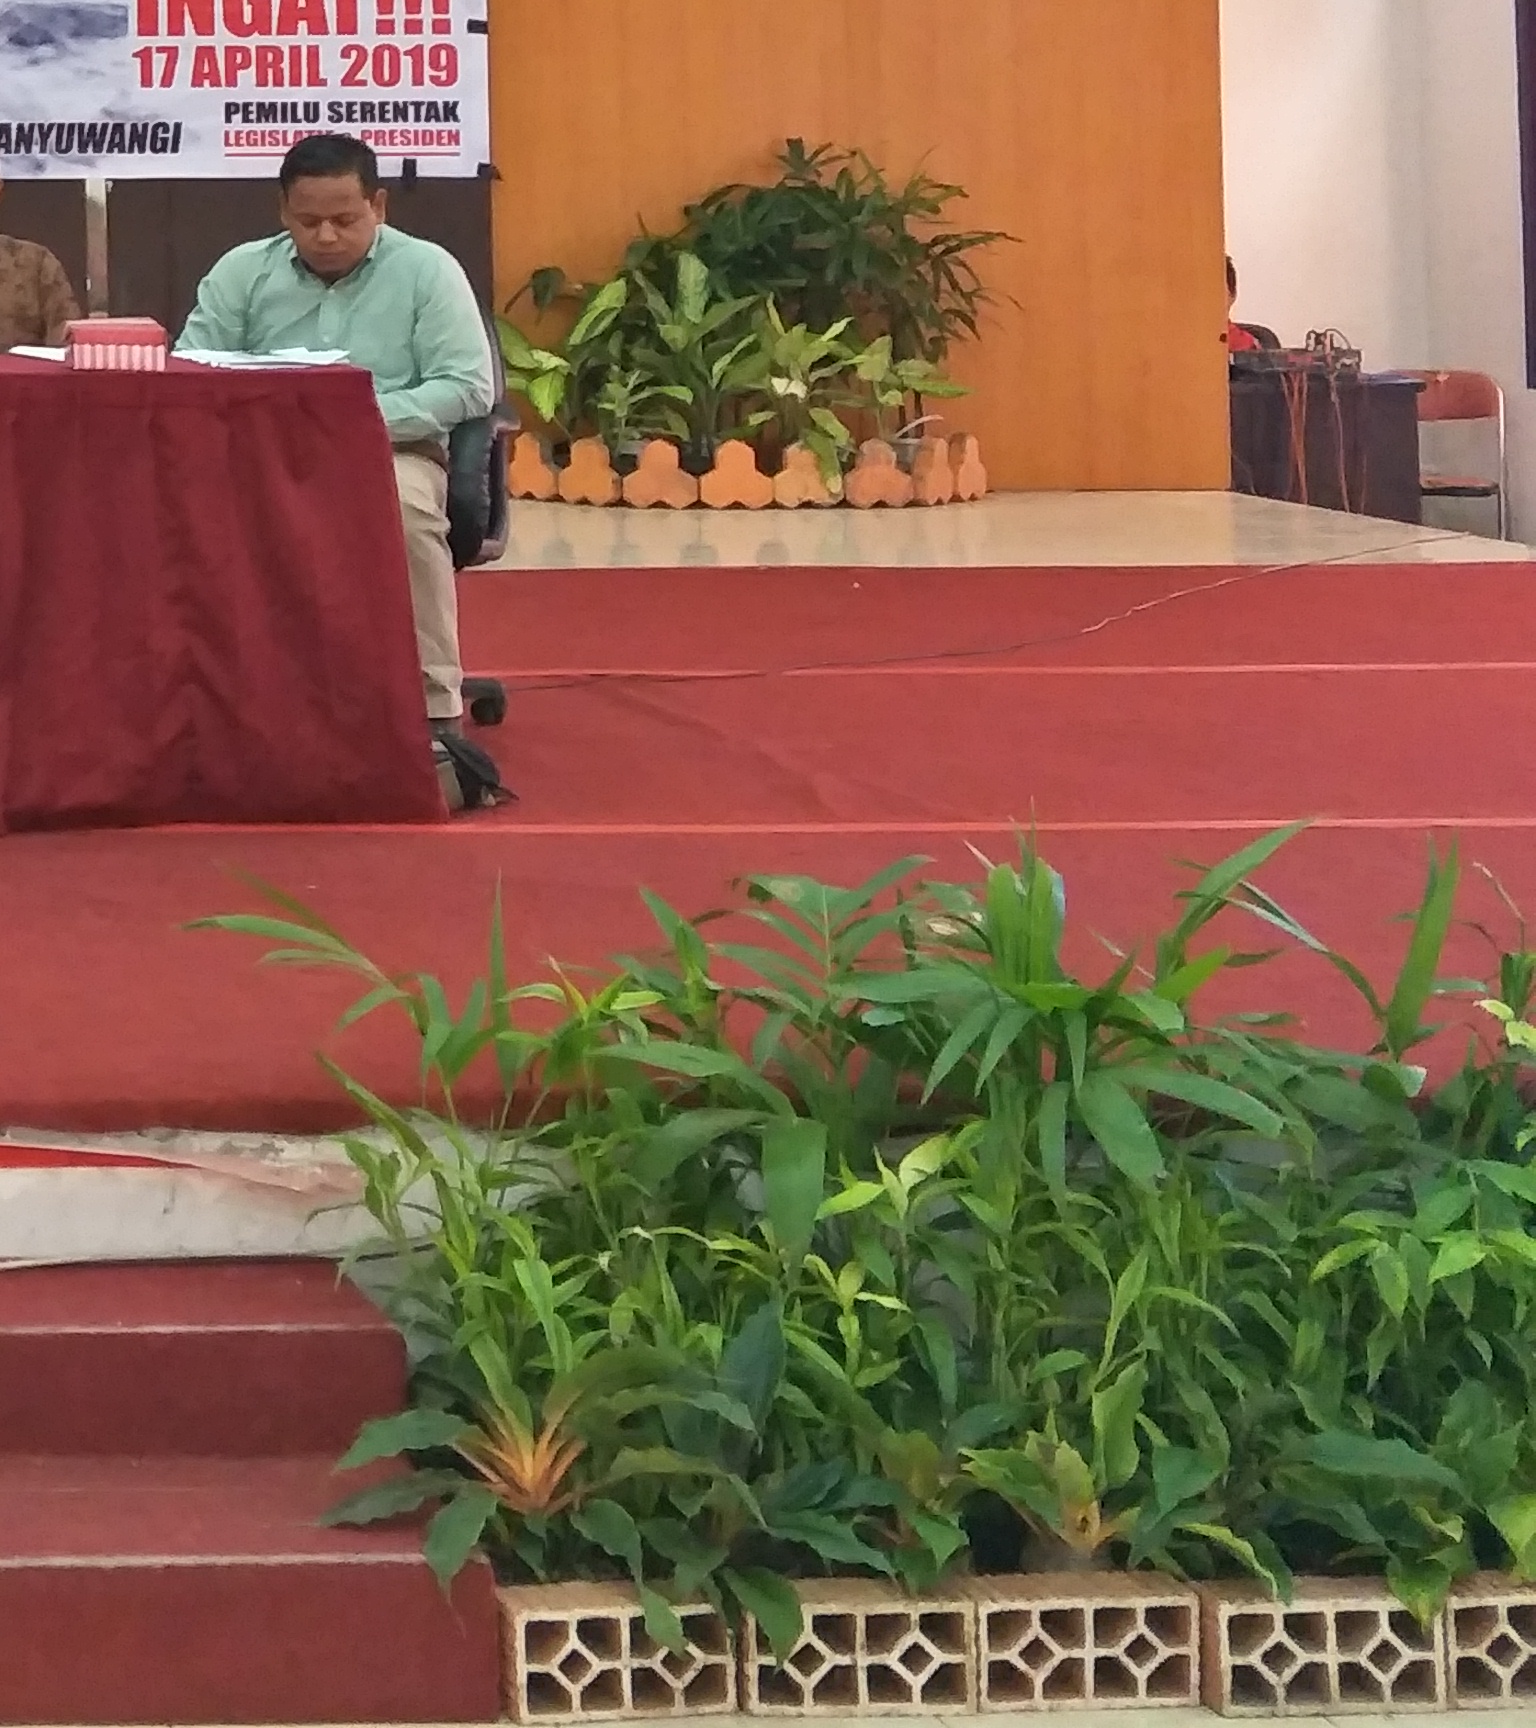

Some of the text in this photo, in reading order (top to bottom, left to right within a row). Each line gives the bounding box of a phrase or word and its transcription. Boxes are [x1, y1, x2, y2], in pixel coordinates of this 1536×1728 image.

[132, 43, 459, 88] 17 APRIL 2019
[225, 100, 461, 124] PEMILU SERENTAK
[360, 129, 461, 148] PRESIDEN
